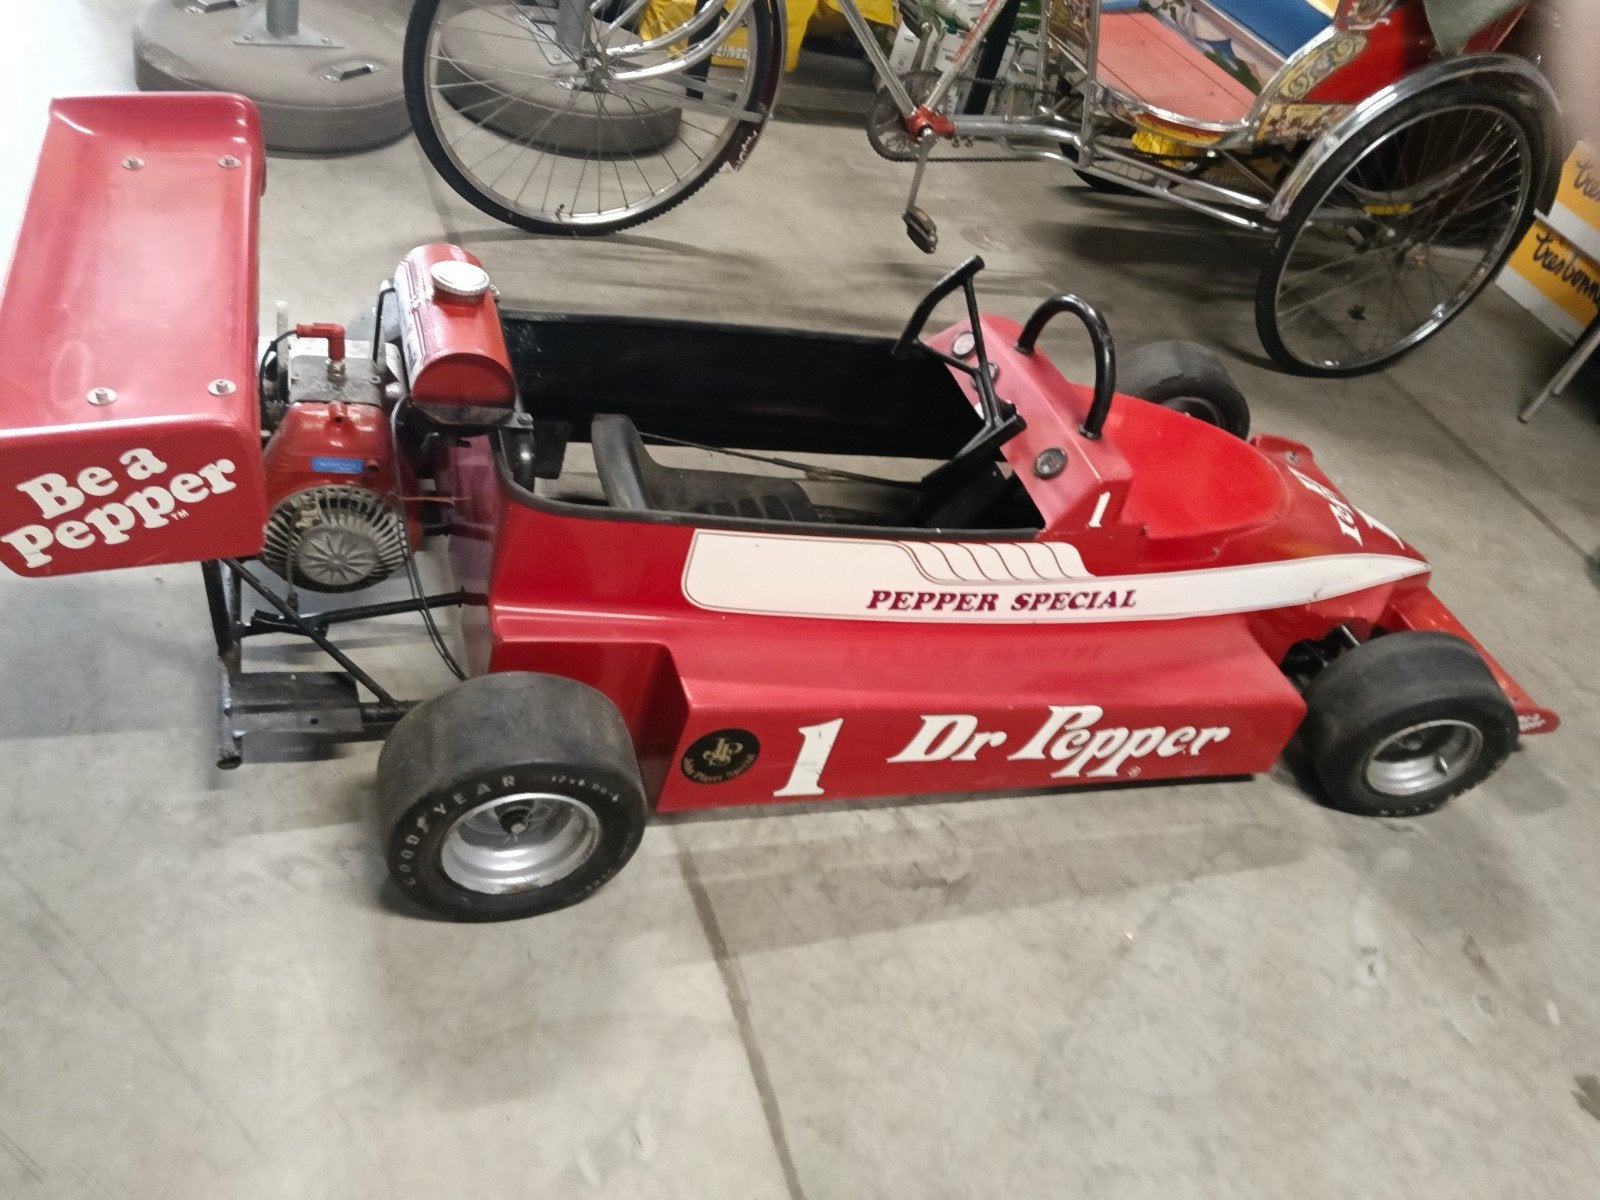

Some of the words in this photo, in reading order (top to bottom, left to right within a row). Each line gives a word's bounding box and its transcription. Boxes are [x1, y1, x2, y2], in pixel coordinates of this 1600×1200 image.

[0, 458, 237, 569] Pepper
[16, 466, 119, 520] Be
[119, 447, 168, 480] a
[1086, 490, 1112, 528] 1
[866, 589, 999, 612] PEPPER
[1011, 588, 1138, 612] SPECIAL
[772, 717, 845, 798] 1
[886, 714, 1008, 763] Dr
[1007, 704, 1232, 779] Pepper
